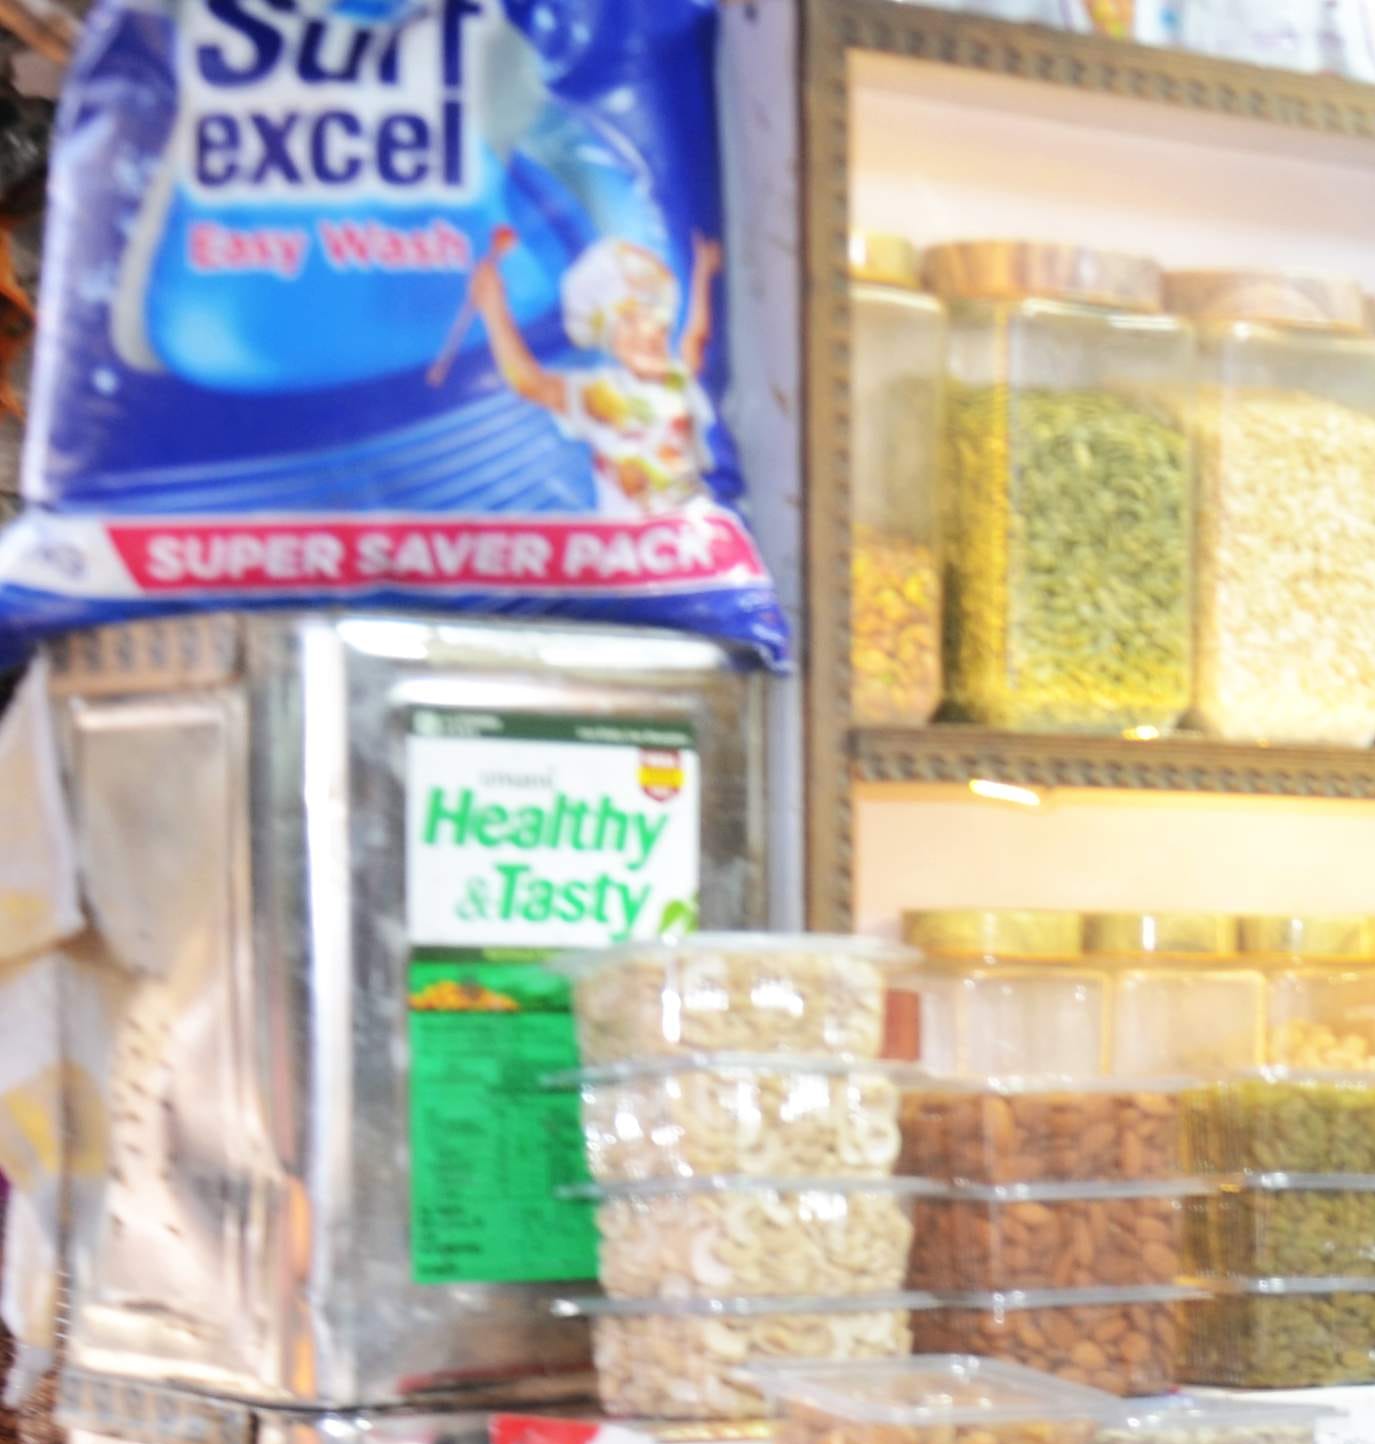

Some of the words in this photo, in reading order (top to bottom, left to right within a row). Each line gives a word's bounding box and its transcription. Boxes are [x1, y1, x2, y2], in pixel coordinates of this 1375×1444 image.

[192, 0, 480, 88] Surf
[190, 101, 466, 189] excel
[188, 222, 304, 278] Easy
[320, 220, 471, 272] Wash
[145, 528, 337, 581] SUPER
[357, 529, 557, 578] SAVER
[421, 785, 671, 872] Healthy
